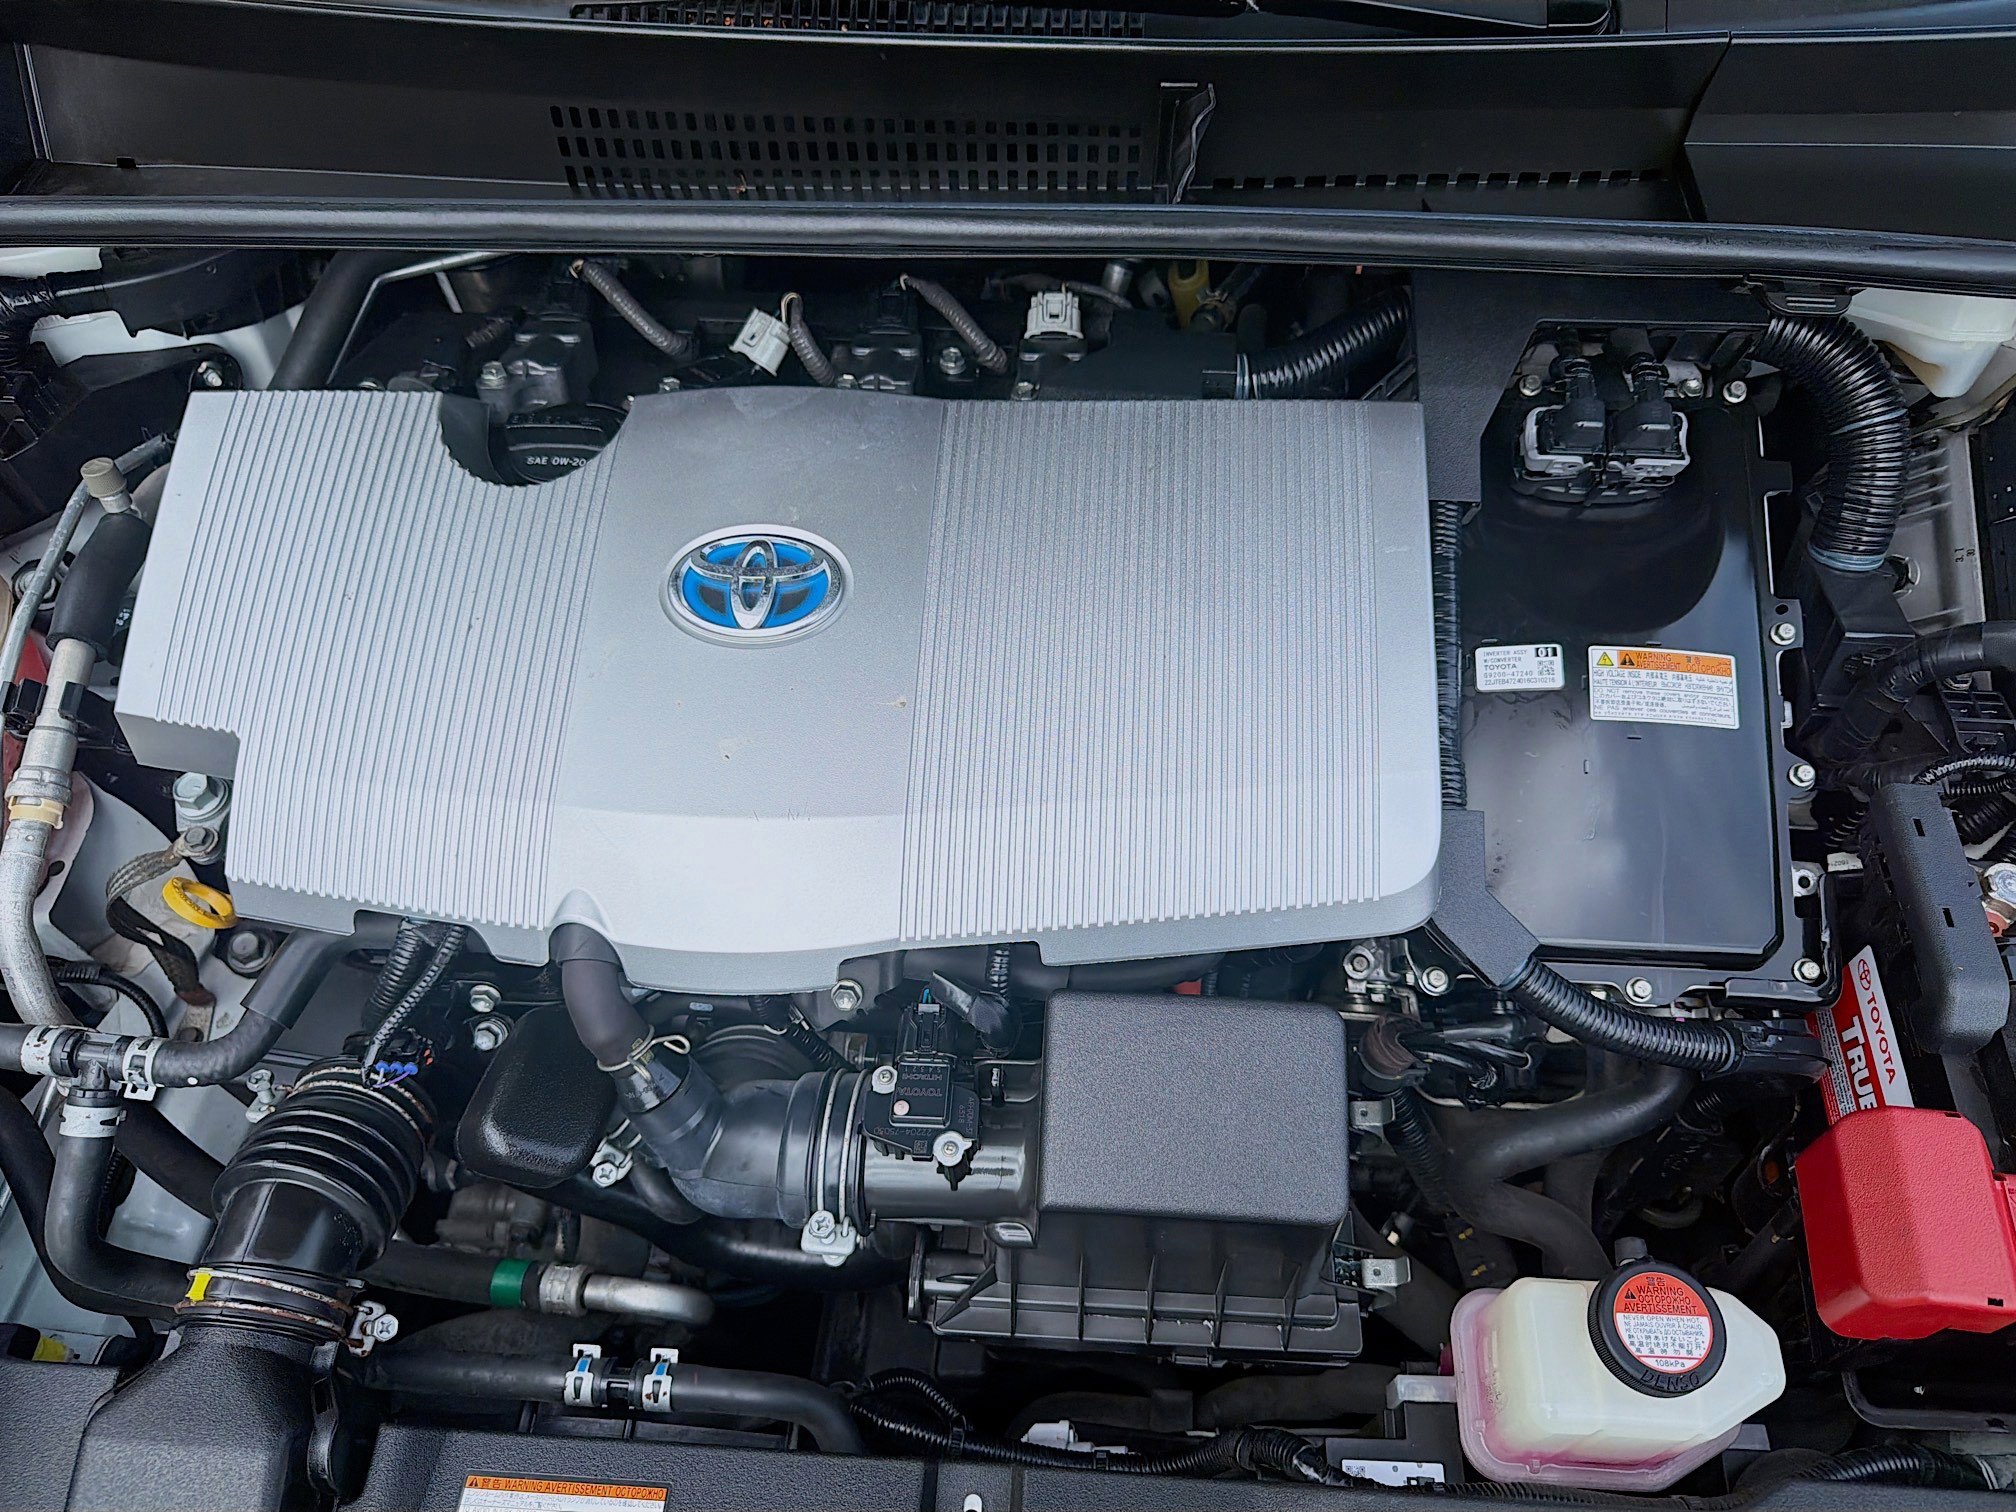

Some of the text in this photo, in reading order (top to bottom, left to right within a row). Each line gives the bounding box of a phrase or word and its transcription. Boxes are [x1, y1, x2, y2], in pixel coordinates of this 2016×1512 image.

[526, 456, 587, 467] SAE 0W-20
[1537, 647, 1553, 658] 01
[1636, 652, 1672, 662] WARNING
[1636, 660, 1681, 671] AVERTISSEMENT
[1686, 663, 1732, 676] ОСТОРОЖНО
[1483, 670, 1534, 678] G9200-47240
[1607, 669, 1626, 678] VOLTAGE
[1867, 991, 1897, 1085] TOYOTA
[901, 1073, 944, 1081] HITACHI
[897, 1086, 943, 1097] TOYOTA
[1645, 1276, 1666, 1287] 警告
[1636, 1285, 1685, 1297] WARNING
[1638, 1294, 1691, 1306] ОСТОРОЖНО
[1624, 1302, 1697, 1315] AVERTISSEMENT
[1682, 1323, 1704, 1331] CHAUD.
[1655, 1359, 1686, 1368] 108kPa
[1640, 1369, 1700, 1392] DENSO
[481, 1477, 502, 1489] 警告
[504, 1478, 544, 1492] WARNING
[544, 1480, 615, 1497] AVERTISSEMENT
[615, 1486, 664, 1500] ОСТОРОЖНО
